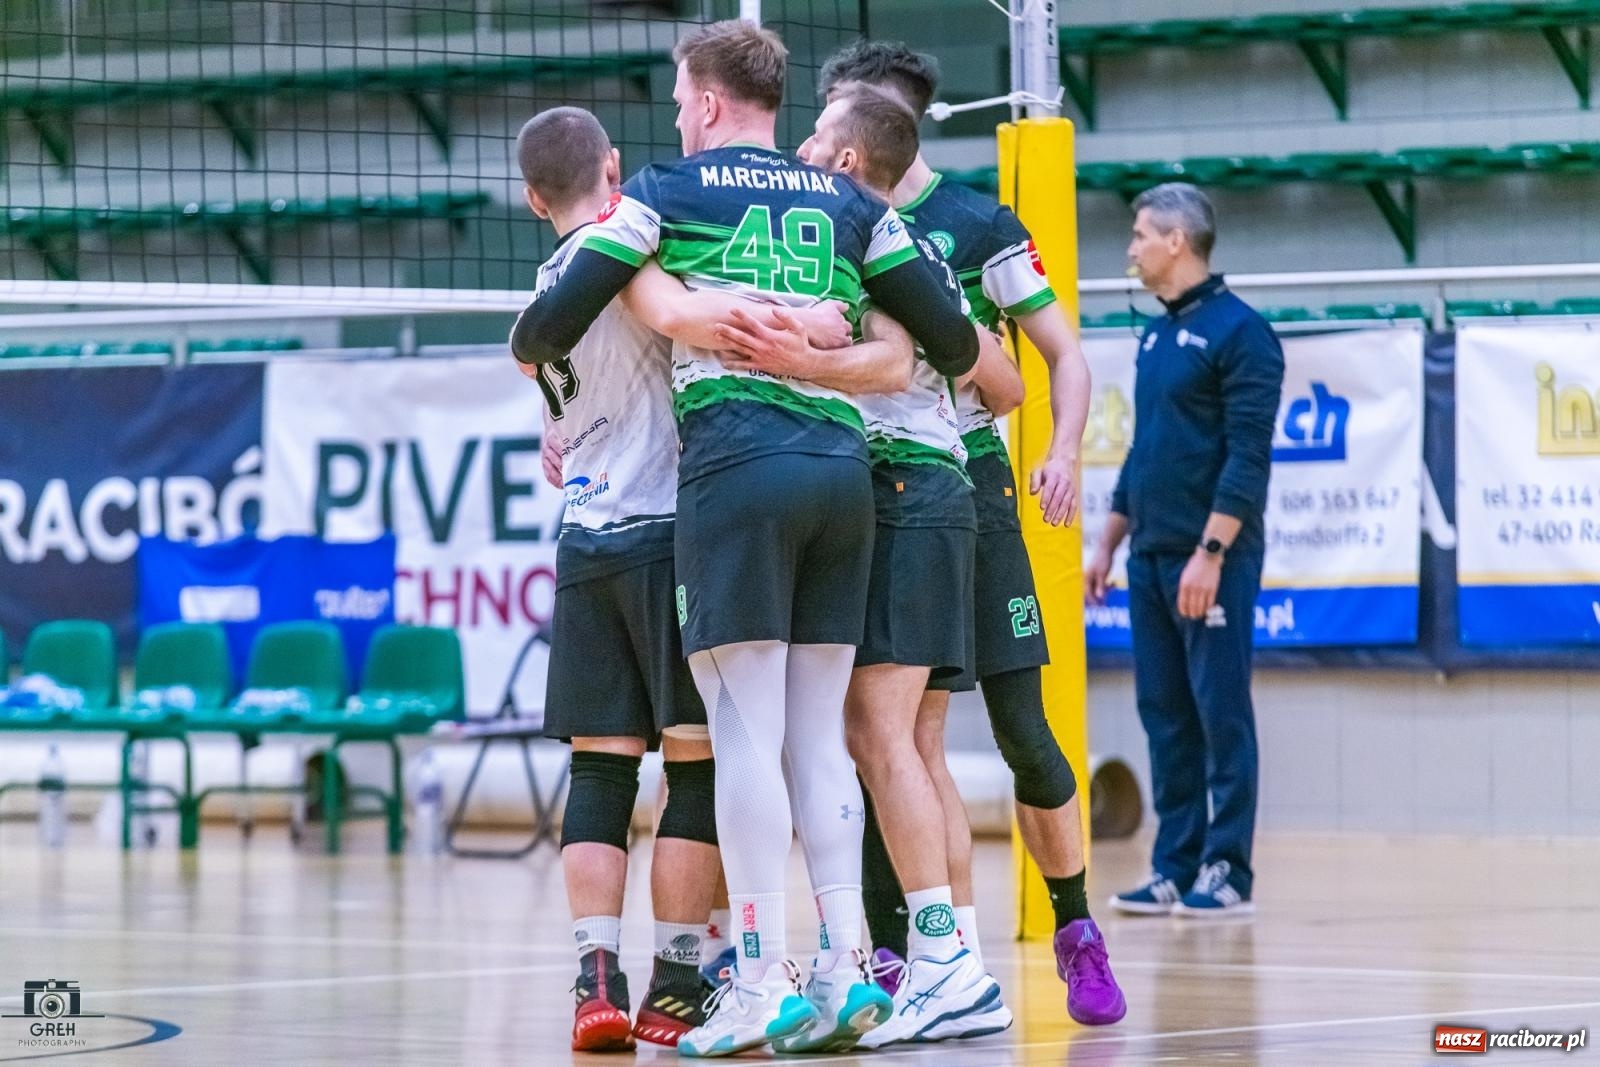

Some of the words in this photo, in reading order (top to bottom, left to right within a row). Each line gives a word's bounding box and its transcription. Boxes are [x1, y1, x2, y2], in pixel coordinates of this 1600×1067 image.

[700, 165, 839, 196] MARCHWIAK
[722, 204, 834, 299] 49
[312, 435, 564, 545] PIVE
[567, 481, 610, 507] ECZENIA
[1551, 484, 1593, 507] 414
[1498, 519, 1573, 545] 47-400
[1008, 595, 1040, 638] 23
[744, 933, 759, 957] XMAS
